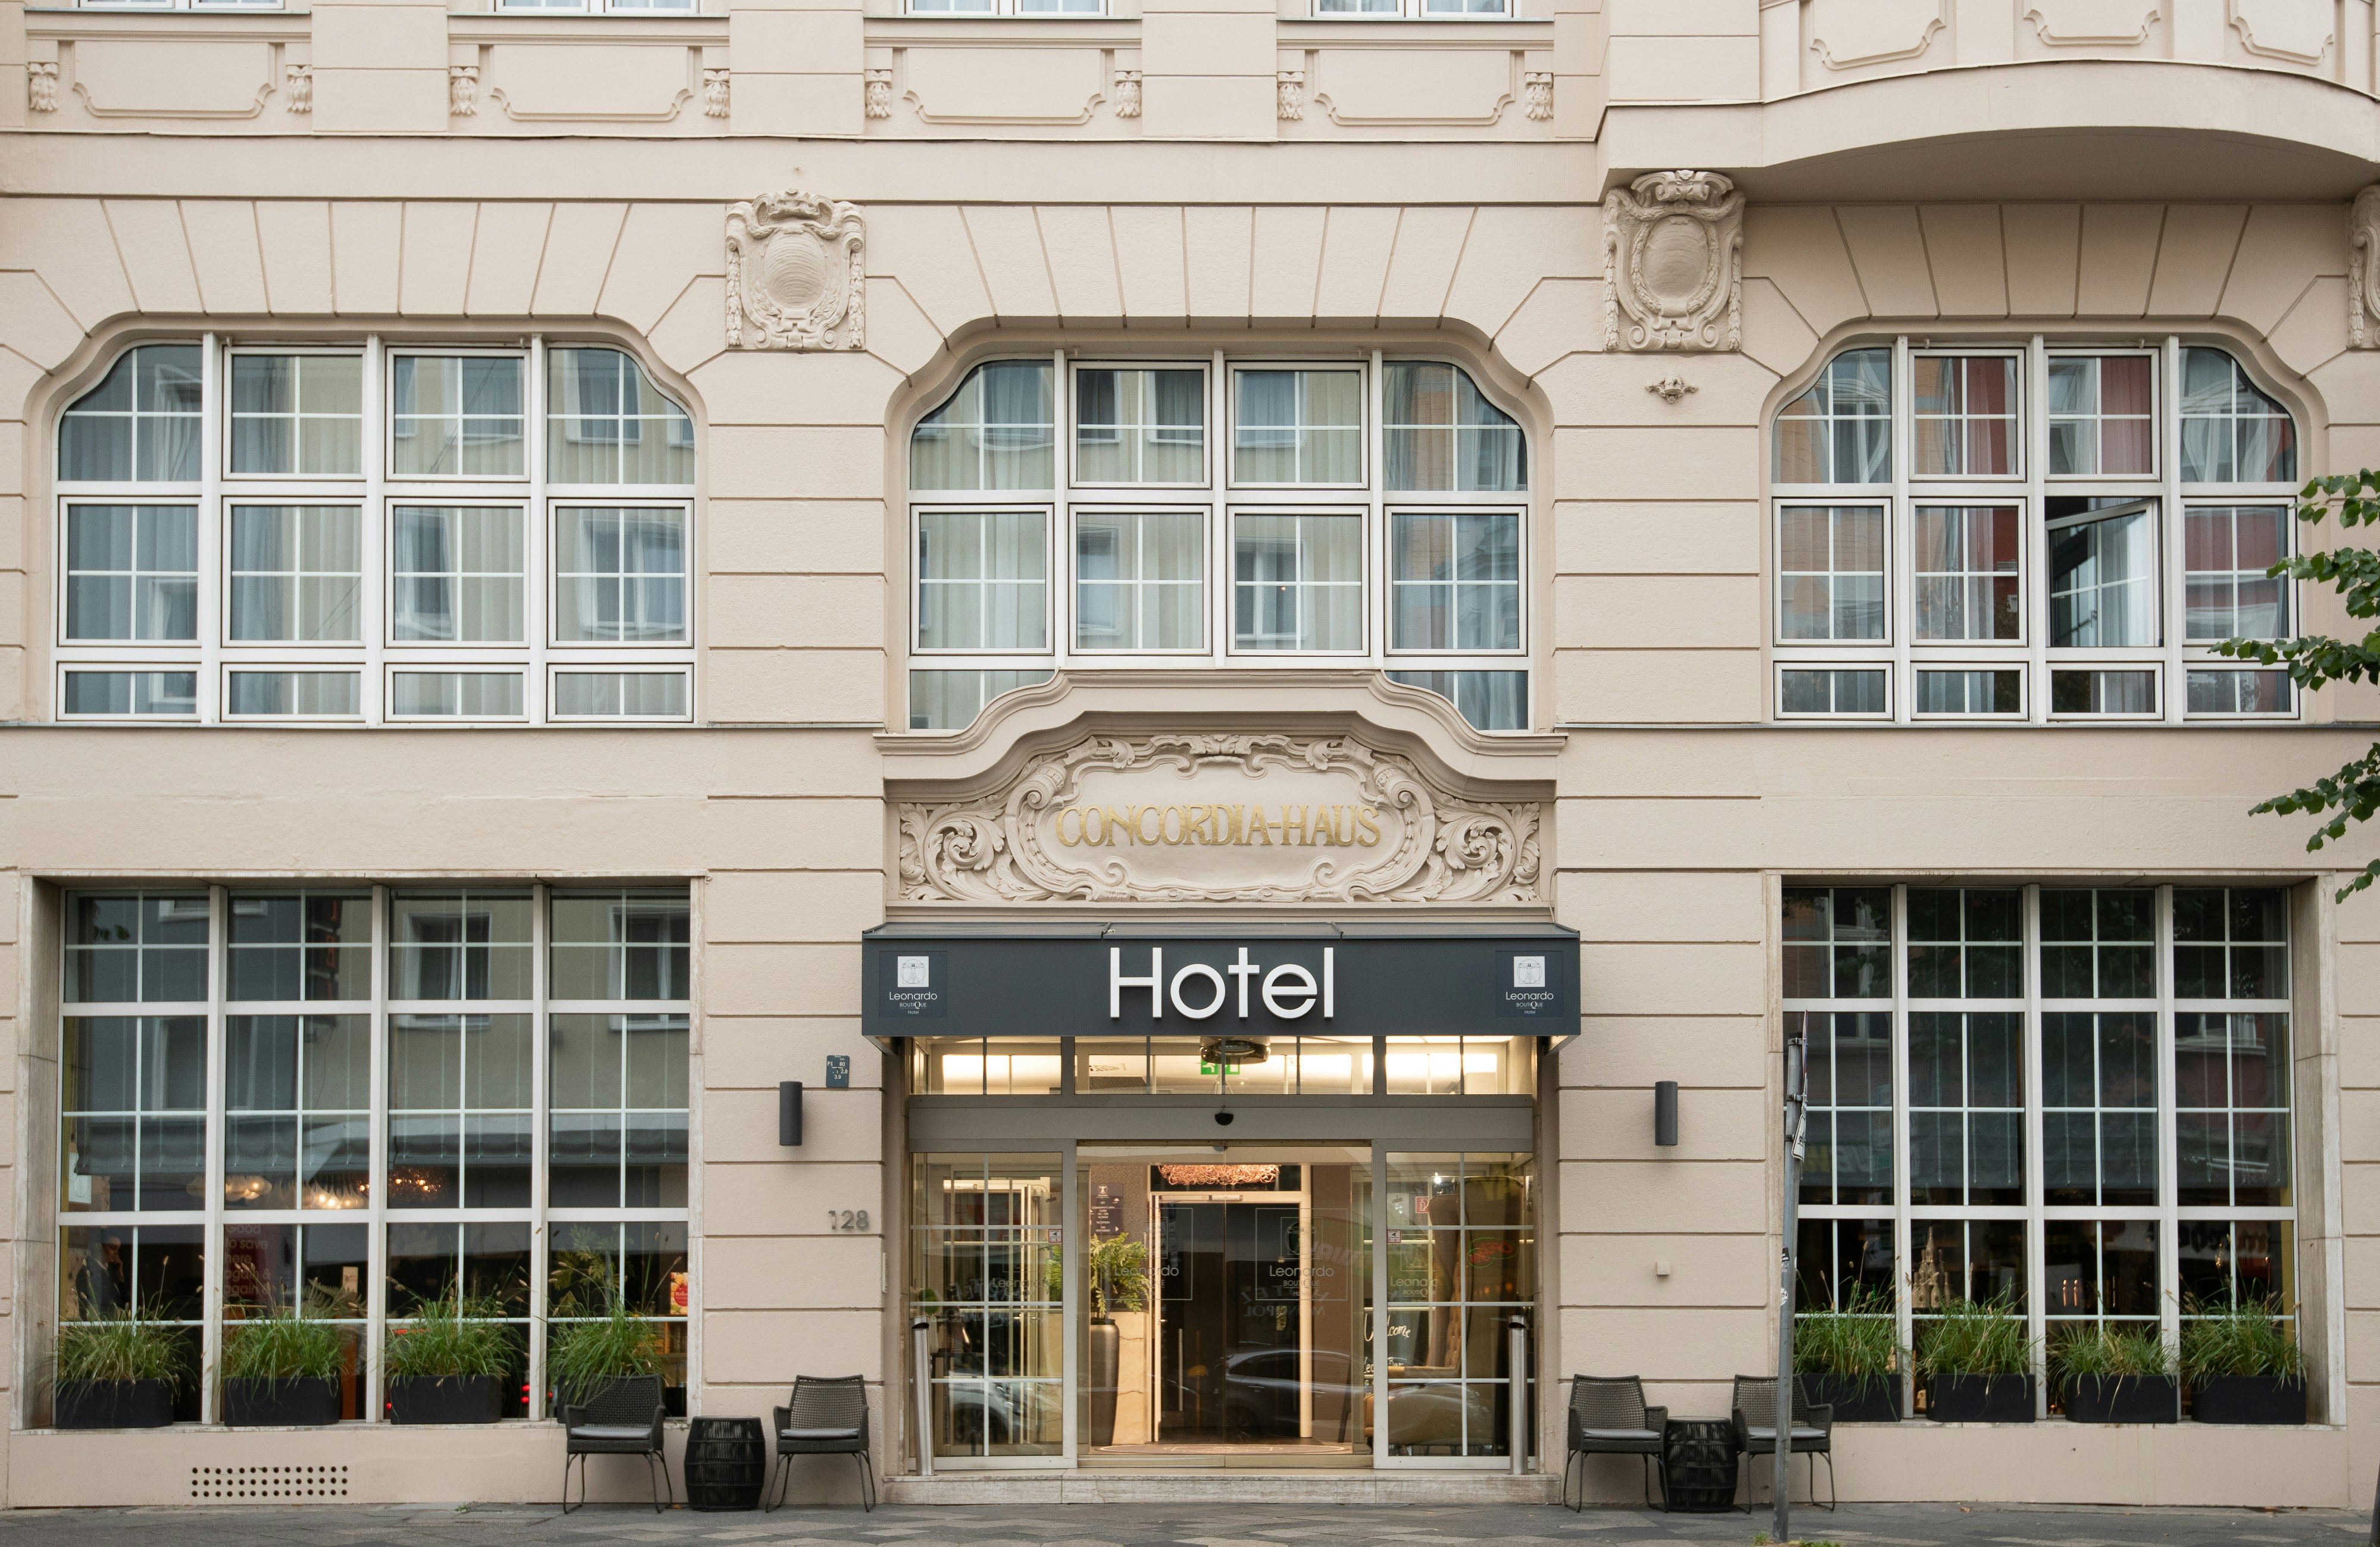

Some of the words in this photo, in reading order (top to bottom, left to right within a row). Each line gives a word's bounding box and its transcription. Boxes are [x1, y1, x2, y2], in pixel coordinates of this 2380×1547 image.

[1056, 803, 1381, 847] CONCORDIA-HAUS
[1109, 946, 1335, 1020] Hotel
[889, 991, 938, 1001] Leonardo
[1505, 991, 1554, 1001] Leonardo
[828, 1209, 869, 1230] 128
[240, 1240, 268, 1250] save
[1114, 1265, 1179, 1276] Leonardo
[1269, 1265, 1334, 1276] Leonardo
